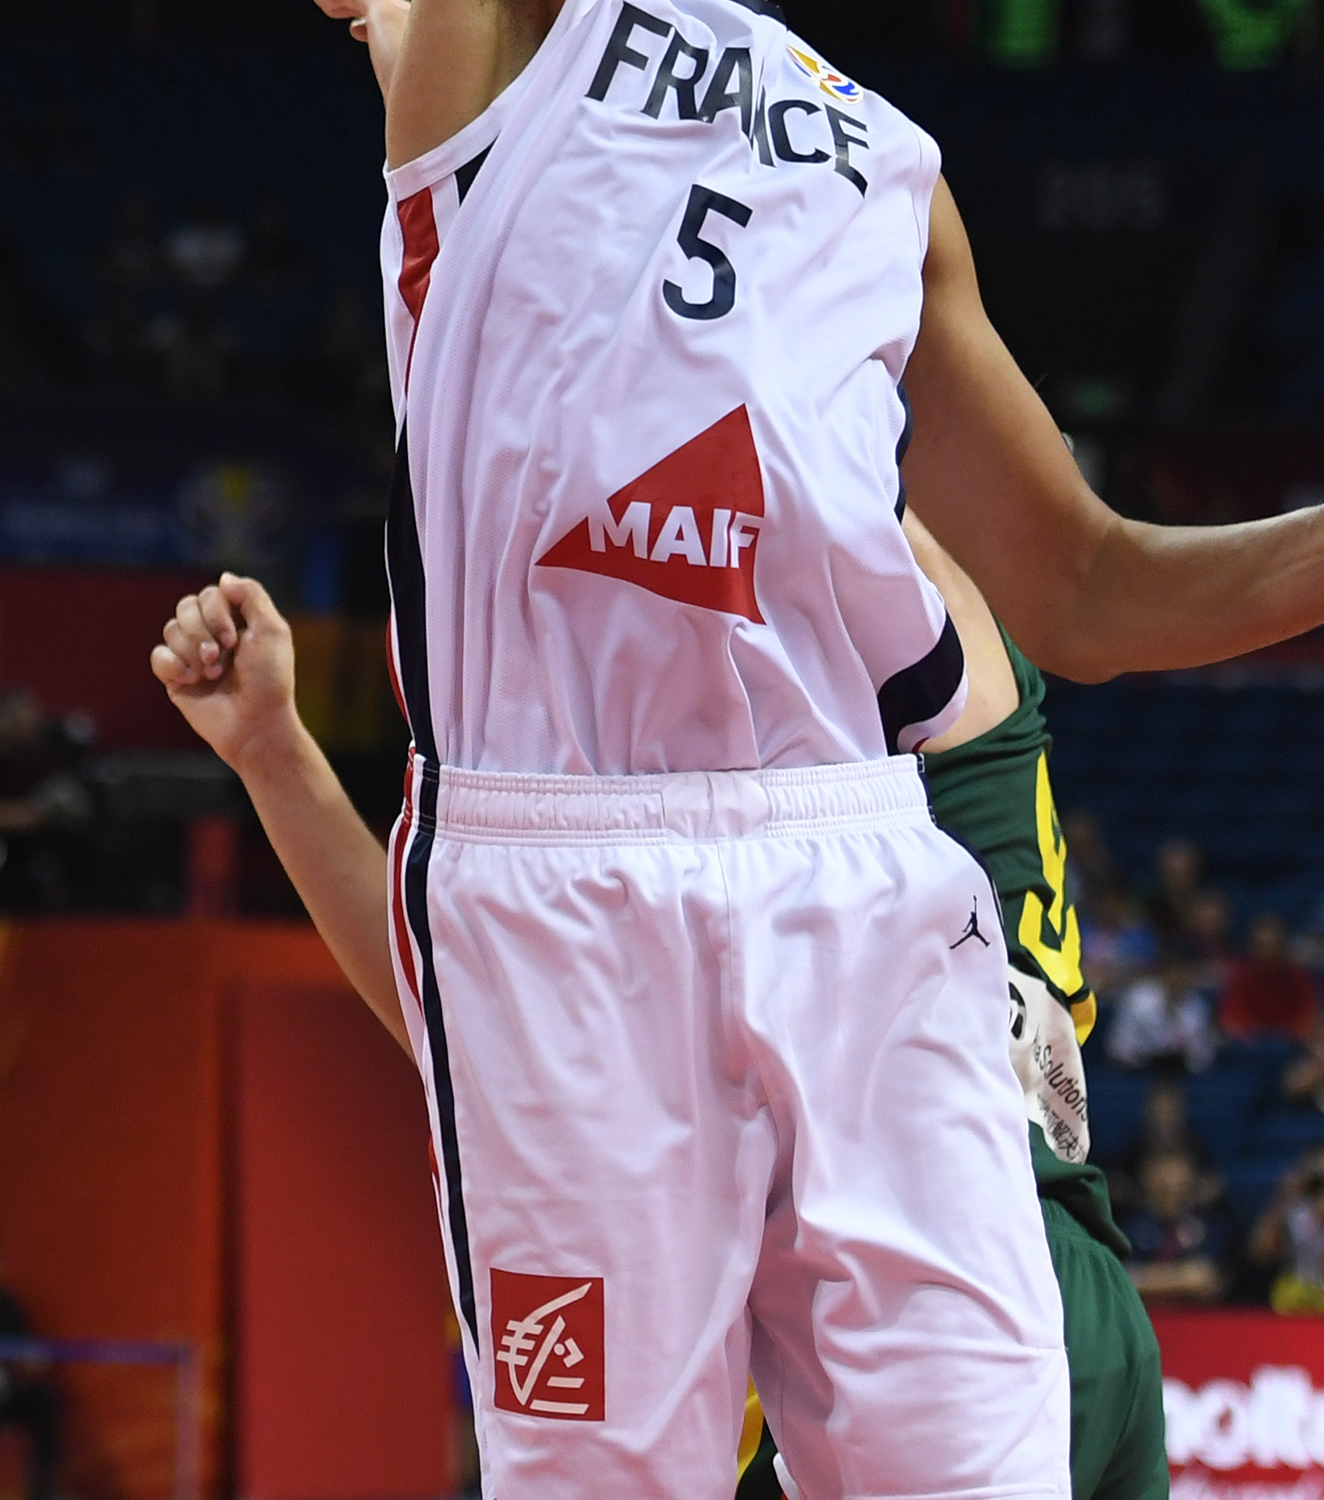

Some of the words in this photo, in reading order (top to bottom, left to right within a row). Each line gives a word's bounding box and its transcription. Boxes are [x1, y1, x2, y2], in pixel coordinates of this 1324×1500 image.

[585, 0, 869, 200] FRANCE
[662, 183, 754, 321] 5
[587, 500, 763, 569] MAIF
